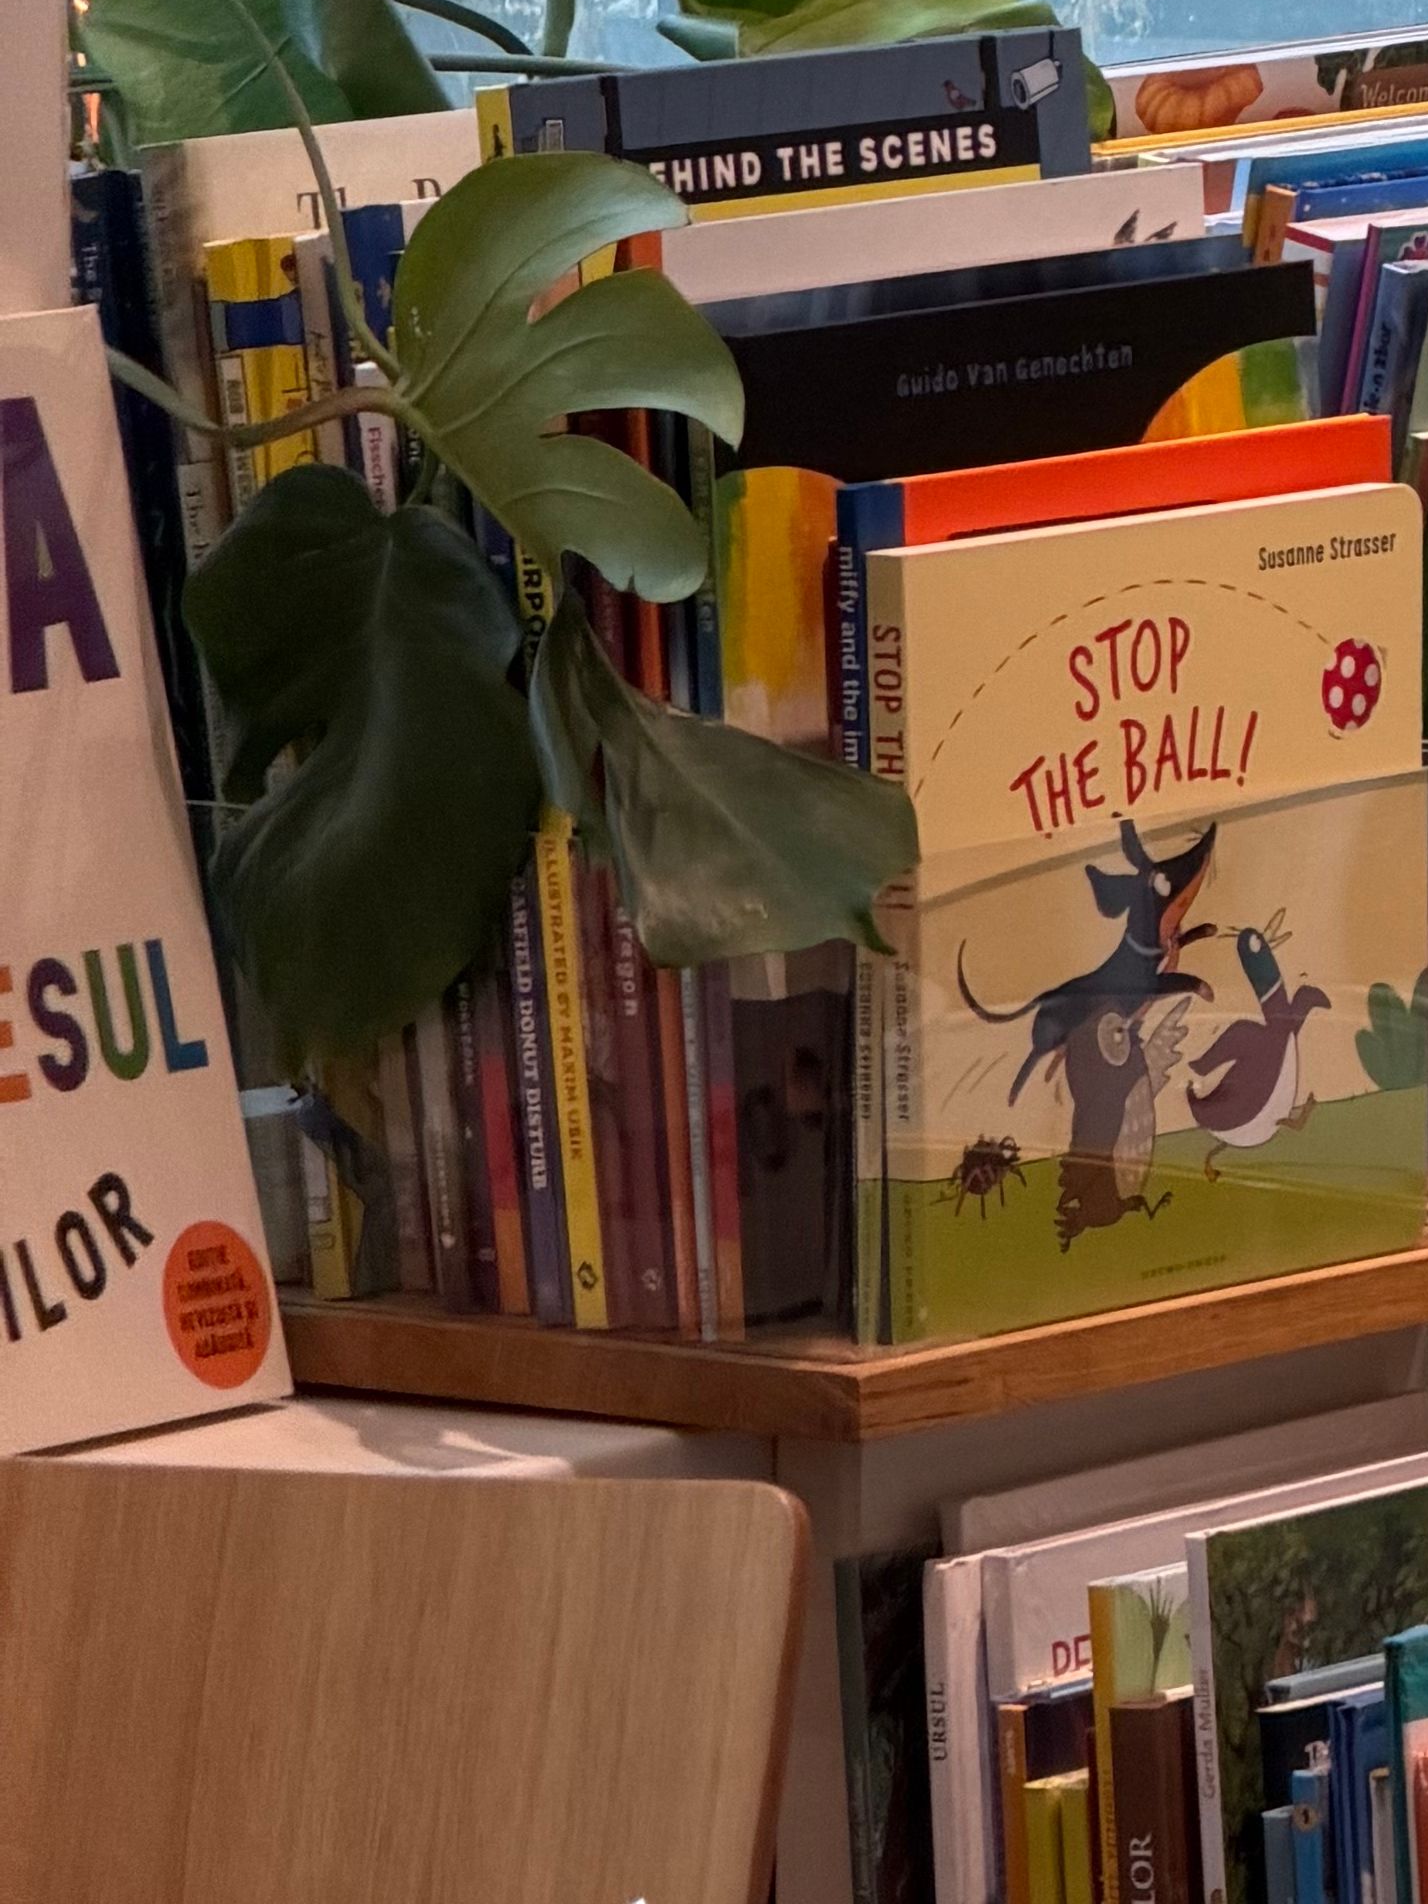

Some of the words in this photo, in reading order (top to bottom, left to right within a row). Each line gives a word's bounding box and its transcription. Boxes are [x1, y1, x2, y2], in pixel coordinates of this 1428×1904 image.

[777, 140, 844, 183] THE
[858, 123, 998, 173] SCENES
[897, 364, 959, 399] Guido
[966, 358, 1009, 388] Van
[1015, 342, 1134, 381] Genechten
[836, 546, 858, 611] miffy
[1256, 542, 1324, 573] Susanne
[1329, 530, 1398, 563] Strasser
[839, 621, 860, 672] and
[871, 623, 903, 715] STOP
[1069, 617, 1191, 724] STOP
[842, 679, 860, 721] the
[1009, 739, 1106, 835] THE
[1120, 704, 1259, 807] BALL!
[542, 838, 570, 986] ILLUSTRATED
[516, 1000, 541, 1081] DONUT
[525, 1087, 549, 1192] DISTURB
[930, 1682, 948, 1761] URSUL
[1198, 1738, 1217, 1799] Gerda
